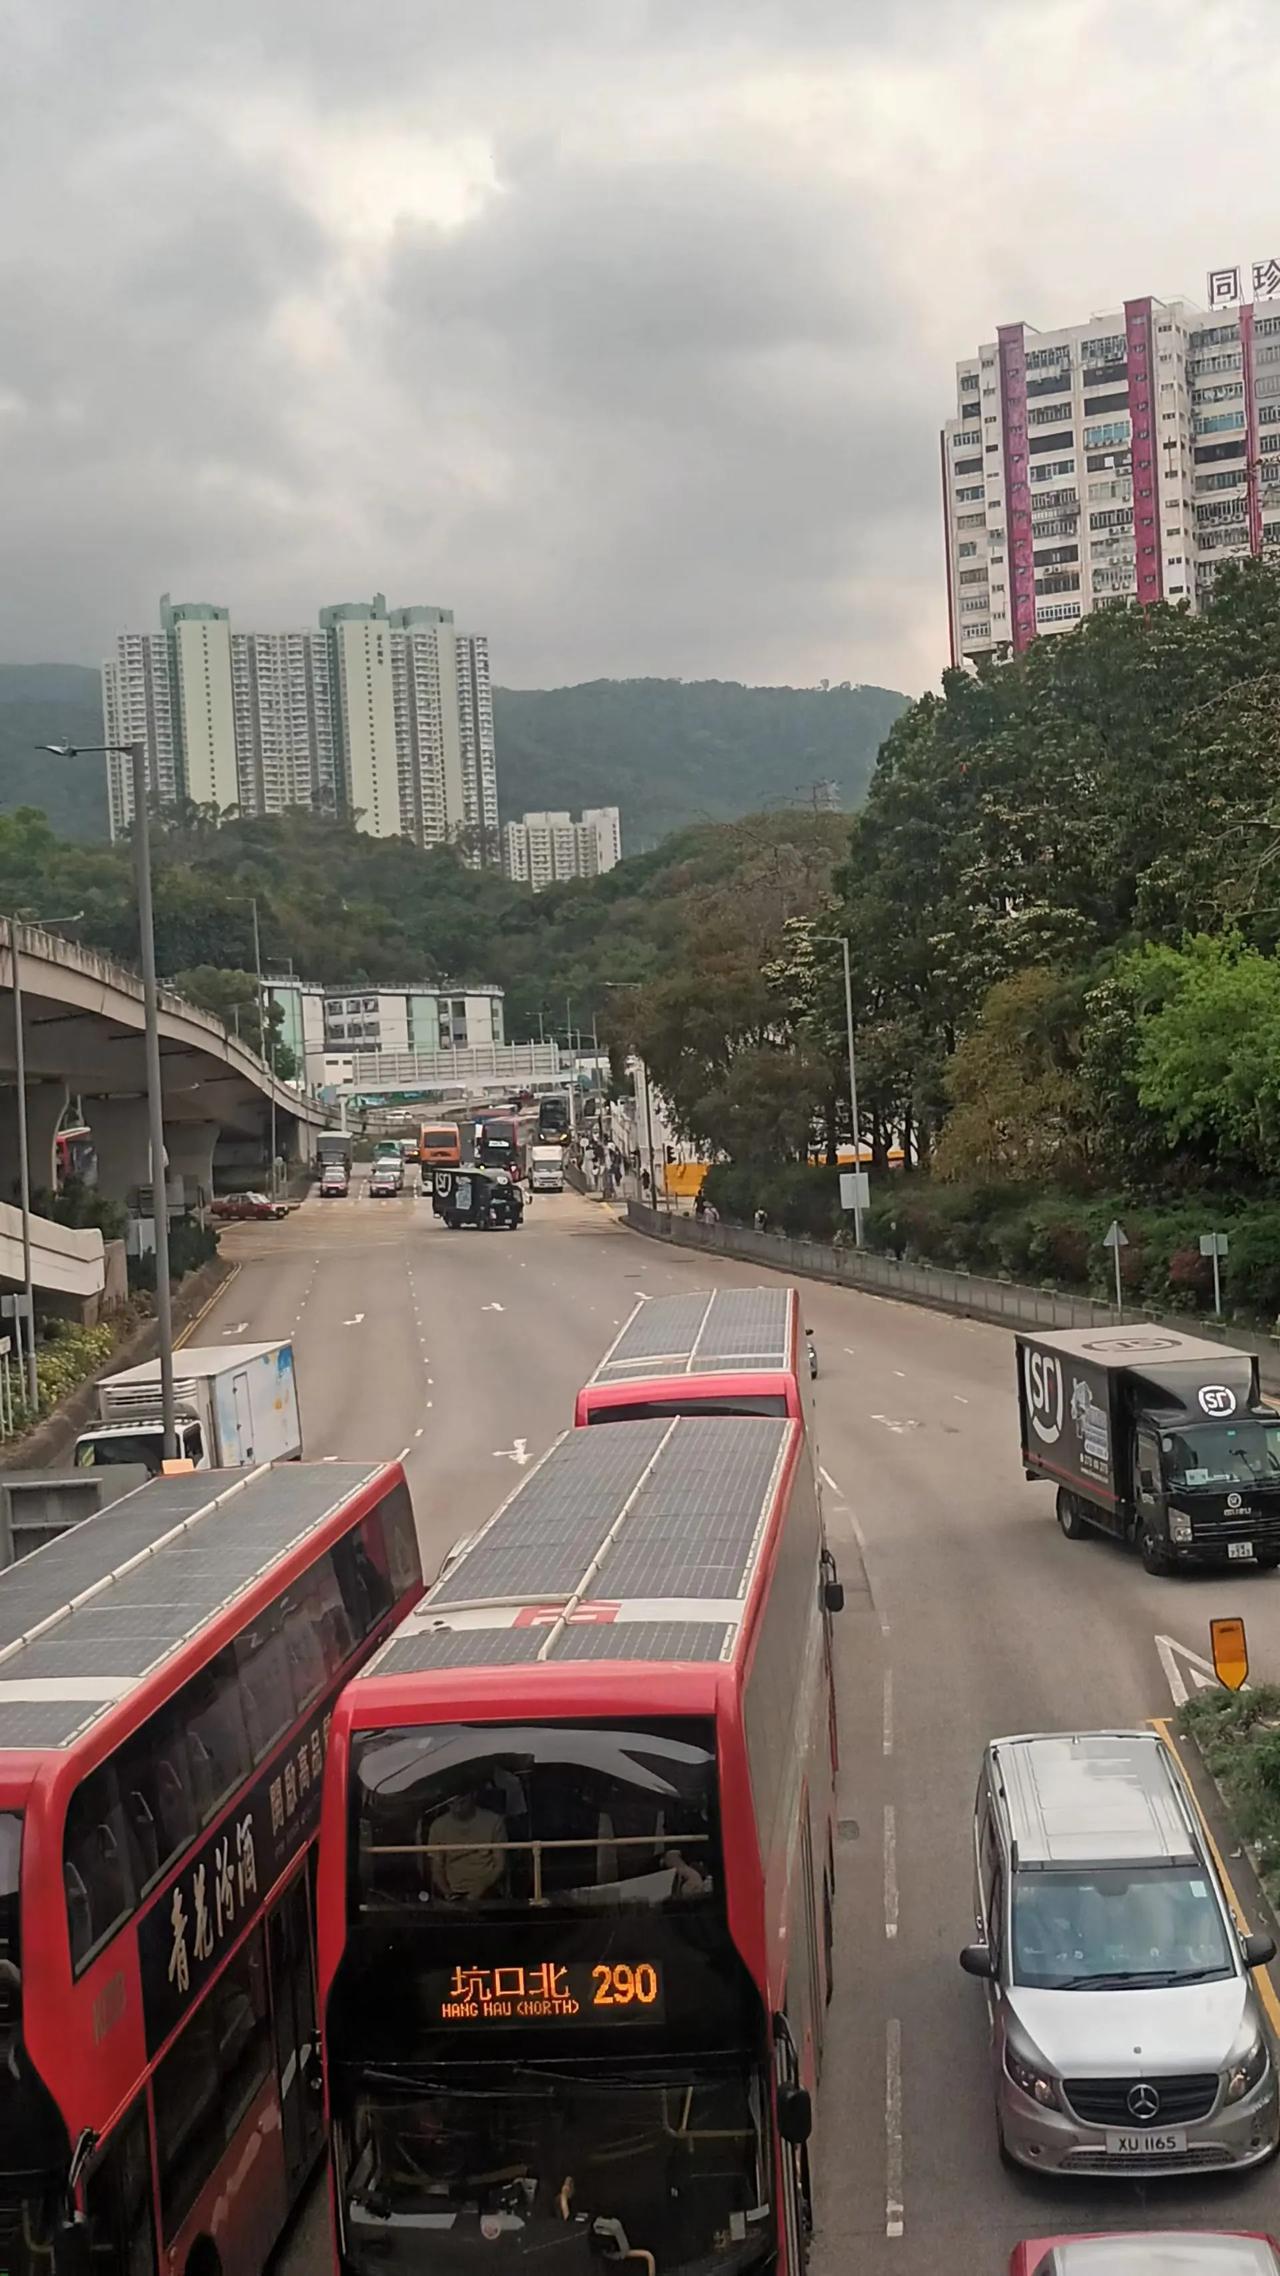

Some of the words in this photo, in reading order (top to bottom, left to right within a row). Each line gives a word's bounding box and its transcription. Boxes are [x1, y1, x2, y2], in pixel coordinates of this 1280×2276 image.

[1210, 259, 1280, 304] 同珍
[450, 1963, 571, 2002] 坑口北
[592, 1963, 658, 2004] 290
[442, 2003, 478, 2018] HANG
[483, 2002, 512, 2017] HAU
[516, 1999, 580, 2017] (NORTH)
[1119, 2137, 1139, 2152] XU
[1144, 2136, 1177, 2151] 1165
